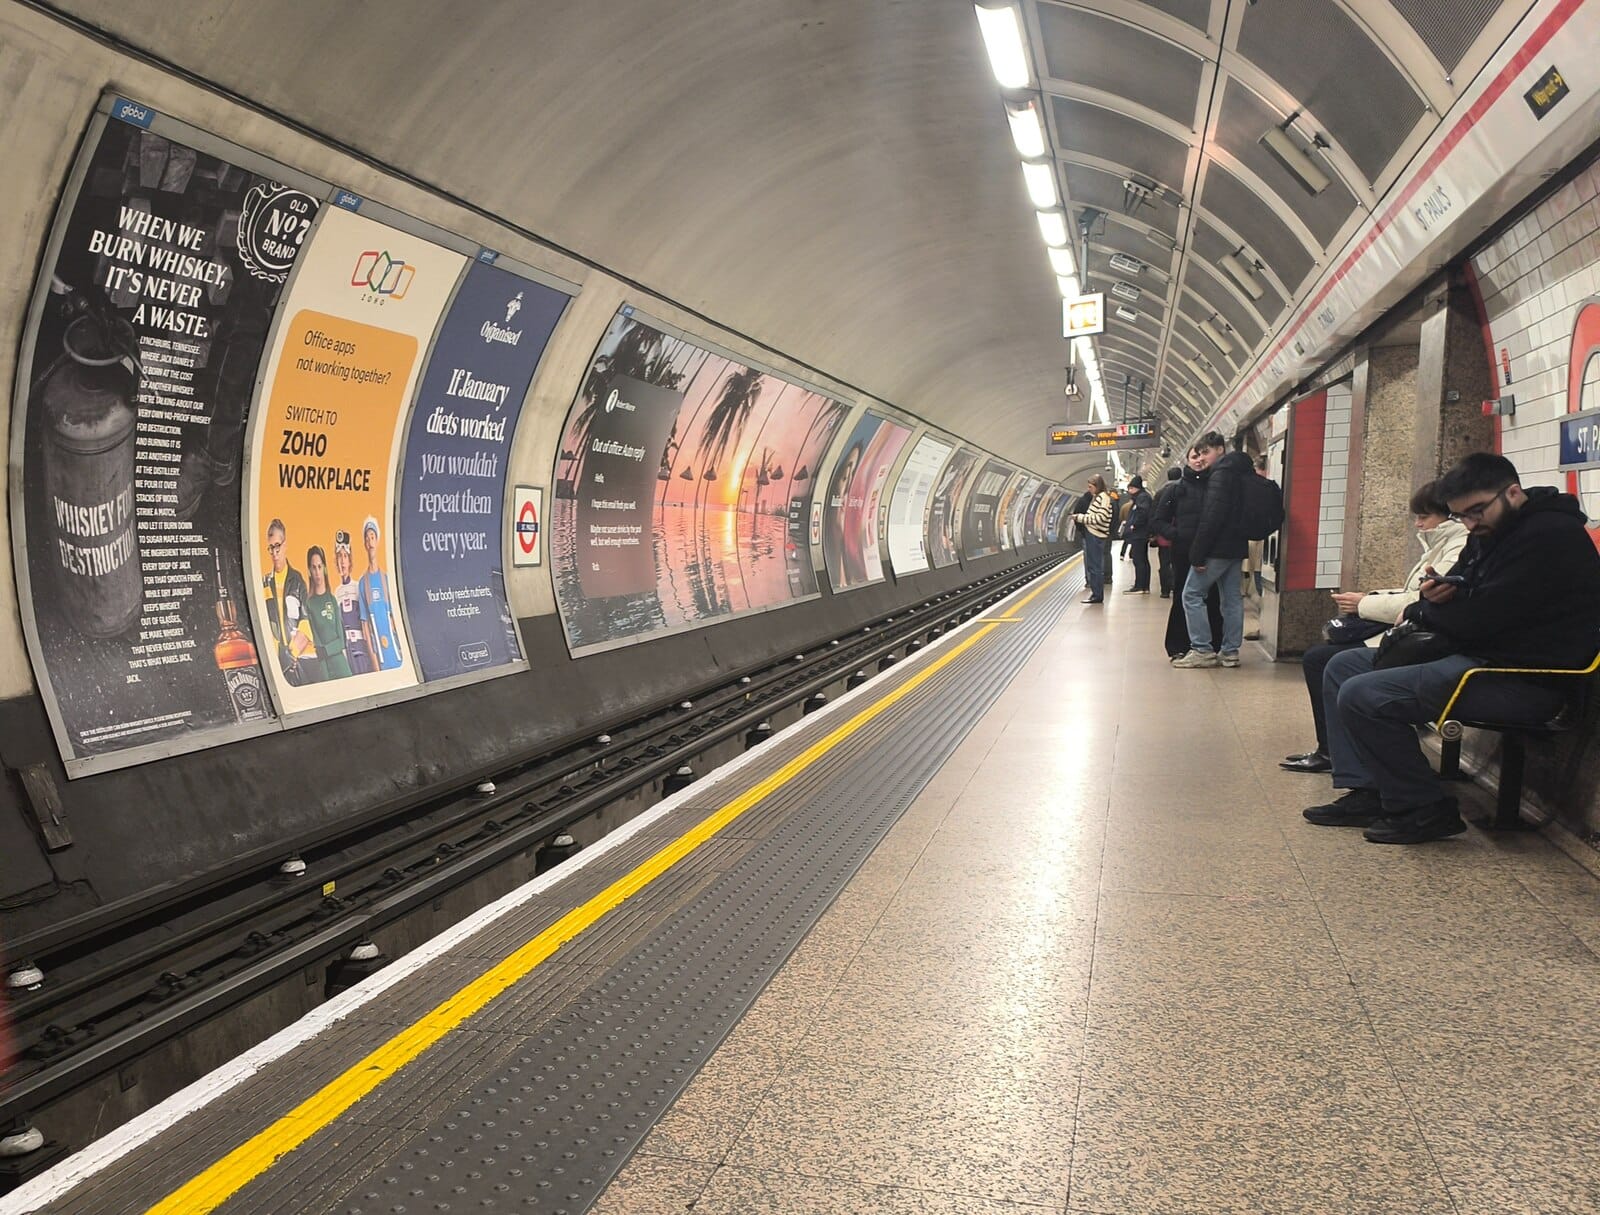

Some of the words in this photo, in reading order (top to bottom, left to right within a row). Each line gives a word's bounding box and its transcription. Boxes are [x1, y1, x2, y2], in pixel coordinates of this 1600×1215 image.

[120, 104, 147, 121] global
[290, 199, 308, 214] OLD
[118, 206, 178, 242] WHEN
[178, 226, 206, 252] WE
[262, 239, 296, 259] BRAND
[88, 230, 148, 264] BURN
[148, 247, 229, 288] WHISKEY,
[104, 266, 142, 294] IT'S
[143, 276, 202, 308] NEVER
[360, 293, 385, 306] ZOHO
[132, 304, 146, 325] A
[150, 308, 208, 338] WASTE.
[480, 320, 523, 346] Organised
[304, 330, 332, 350] Office
[333, 340, 356, 357] apps
[140, 350, 160, 362] WHERE
[160, 354, 172, 363] JACK
[142, 366, 148, 374] IS
[148, 366, 163, 376] BORN
[163, 368, 170, 377] AT
[170, 370, 180, 379] THE
[180, 372, 194, 381] COST
[296, 357, 314, 372] not
[314, 361, 350, 381] working
[350, 367, 391, 385] together?
[140, 380, 148, 388] OF
[148, 381, 172, 392] ANOTHER
[446, 368, 465, 395] If
[459, 371, 510, 411] January
[156, 396, 176, 406] TALKING
[176, 399, 193, 409] ABOUT
[193, 401, 204, 410] OUR
[138, 408, 151, 418] VERY
[151, 410, 163, 419] OWN
[190, 415, 211, 424] WHISKEY
[286, 405, 324, 425] SWITCH
[326, 410, 338, 426] TO
[137, 422, 147, 431] FOR
[427, 406, 457, 436] diets
[461, 414, 507, 444] worked,
[136, 437, 147, 445] AND
[148, 438, 170, 448] BURNING
[170, 439, 175, 448] IT
[175, 440, 181, 449] IS
[280, 430, 327, 457] ZOHO
[592, 438, 603, 452] Out
[1578, 427, 1590, 453] ST.
[136, 451, 148, 459] JUST
[149, 452, 171, 461] ANOTHER
[172, 454, 182, 462] DAY
[143, 466, 153, 474] THE
[419, 453, 444, 480] you
[448, 452, 498, 478] wouldn't
[135, 480, 143, 488] WE
[144, 480, 157, 488] POUR
[164, 481, 177, 489] OVER
[279, 464, 371, 492] WORKPLACE
[136, 494, 155, 502] STACKS
[419, 490, 461, 521] repeat
[461, 489, 491, 514] them
[54, 496, 114, 537] WHISKEY
[136, 508, 154, 516] STRIKE
[139, 535, 146, 543] TO
[422, 532, 459, 558] every
[460, 532, 487, 558] year.
[179, 548, 191, 556] THAT
[191, 548, 209, 556] FILTERS
[142, 562, 158, 571] EVERY
[158, 562, 171, 570] DROP
[179, 561, 191, 569] JACK
[144, 576, 154, 584] FOR
[154, 576, 167, 584] THAT
[167, 575, 187, 583] SMOOTH
[161, 589, 171, 597] DRY
[172, 588, 192, 596] JANUARY
[426, 589, 439, 602] Your
[439, 587, 455, 603] body
[455, 586, 470, 599] needs
[143, 604, 159, 612] KEEPS
[159, 602, 180, 611] WHISKEY
[447, 608, 457, 617] not
[140, 617, 151, 626] OUT
[152, 616, 159, 625] OF
[140, 632, 149, 640] WE
[149, 630, 163, 639] MAKE
[163, 628, 184, 637] WHISKEY
[131, 646, 145, 654] THAT
[145, 644, 163, 653] NEVER
[162, 642, 176, 651] GOES
[128, 660, 147, 669] THAT'S
[147, 657, 161, 666] WHAT
[162, 655, 179, 664] MAKES
